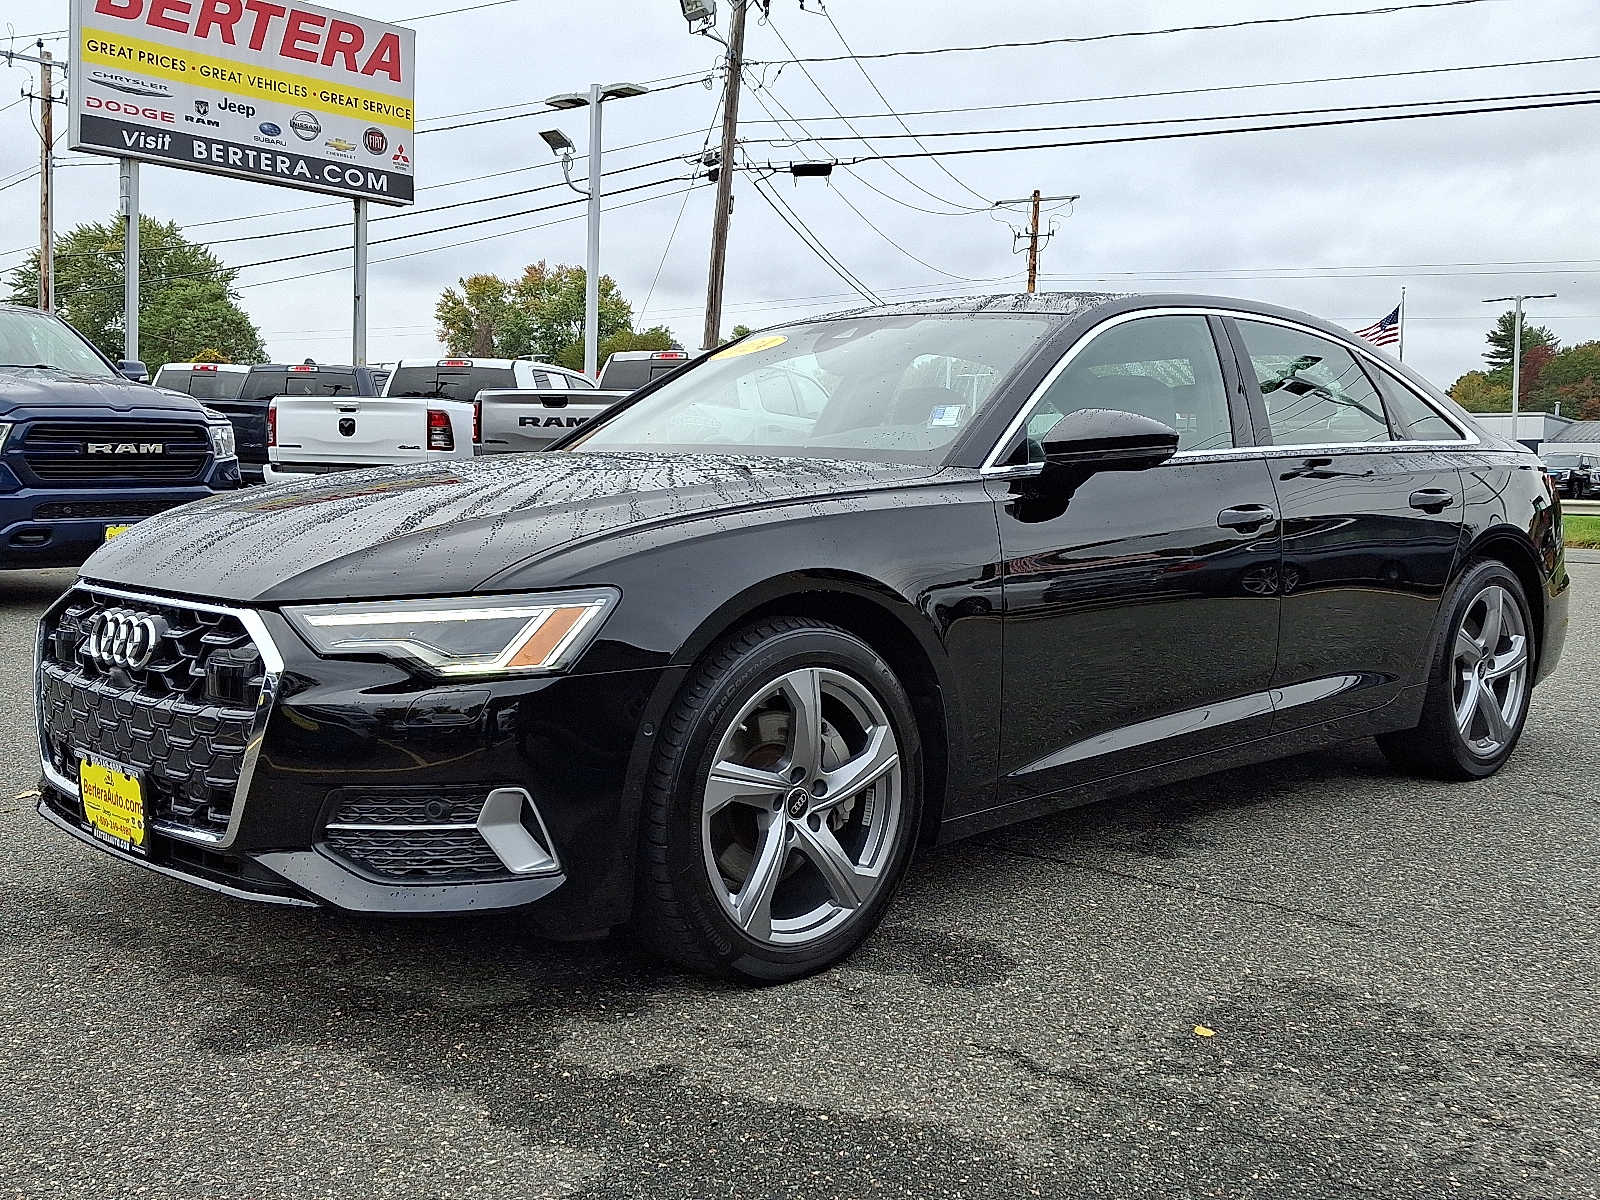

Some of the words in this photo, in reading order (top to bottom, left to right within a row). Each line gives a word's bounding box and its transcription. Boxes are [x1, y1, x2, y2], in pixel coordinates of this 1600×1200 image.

[86, 39, 133, 60] GREAT
[138, 50, 186, 72] PRICES
[199, 64, 243, 84] GREAT
[247, 74, 308, 98] VEHICLES
[319, 90, 359, 109] GREAT
[362, 99, 412, 121] SERVICE
[92, 71, 169, 92] CHRYSLER
[86, 96, 176, 123] DODGE
[217, 97, 256, 118] Jeep
[184, 114, 220, 128] RAM
[292, 121, 319, 131] NISSAN
[253, 135, 287, 147] SUBARU
[369, 134, 383, 150] FIAT
[121, 129, 172, 151] Visit
[193, 139, 388, 193] BERTERA.COM
[518, 416, 592, 428] RAM
[87, 443, 163, 454] RAM
